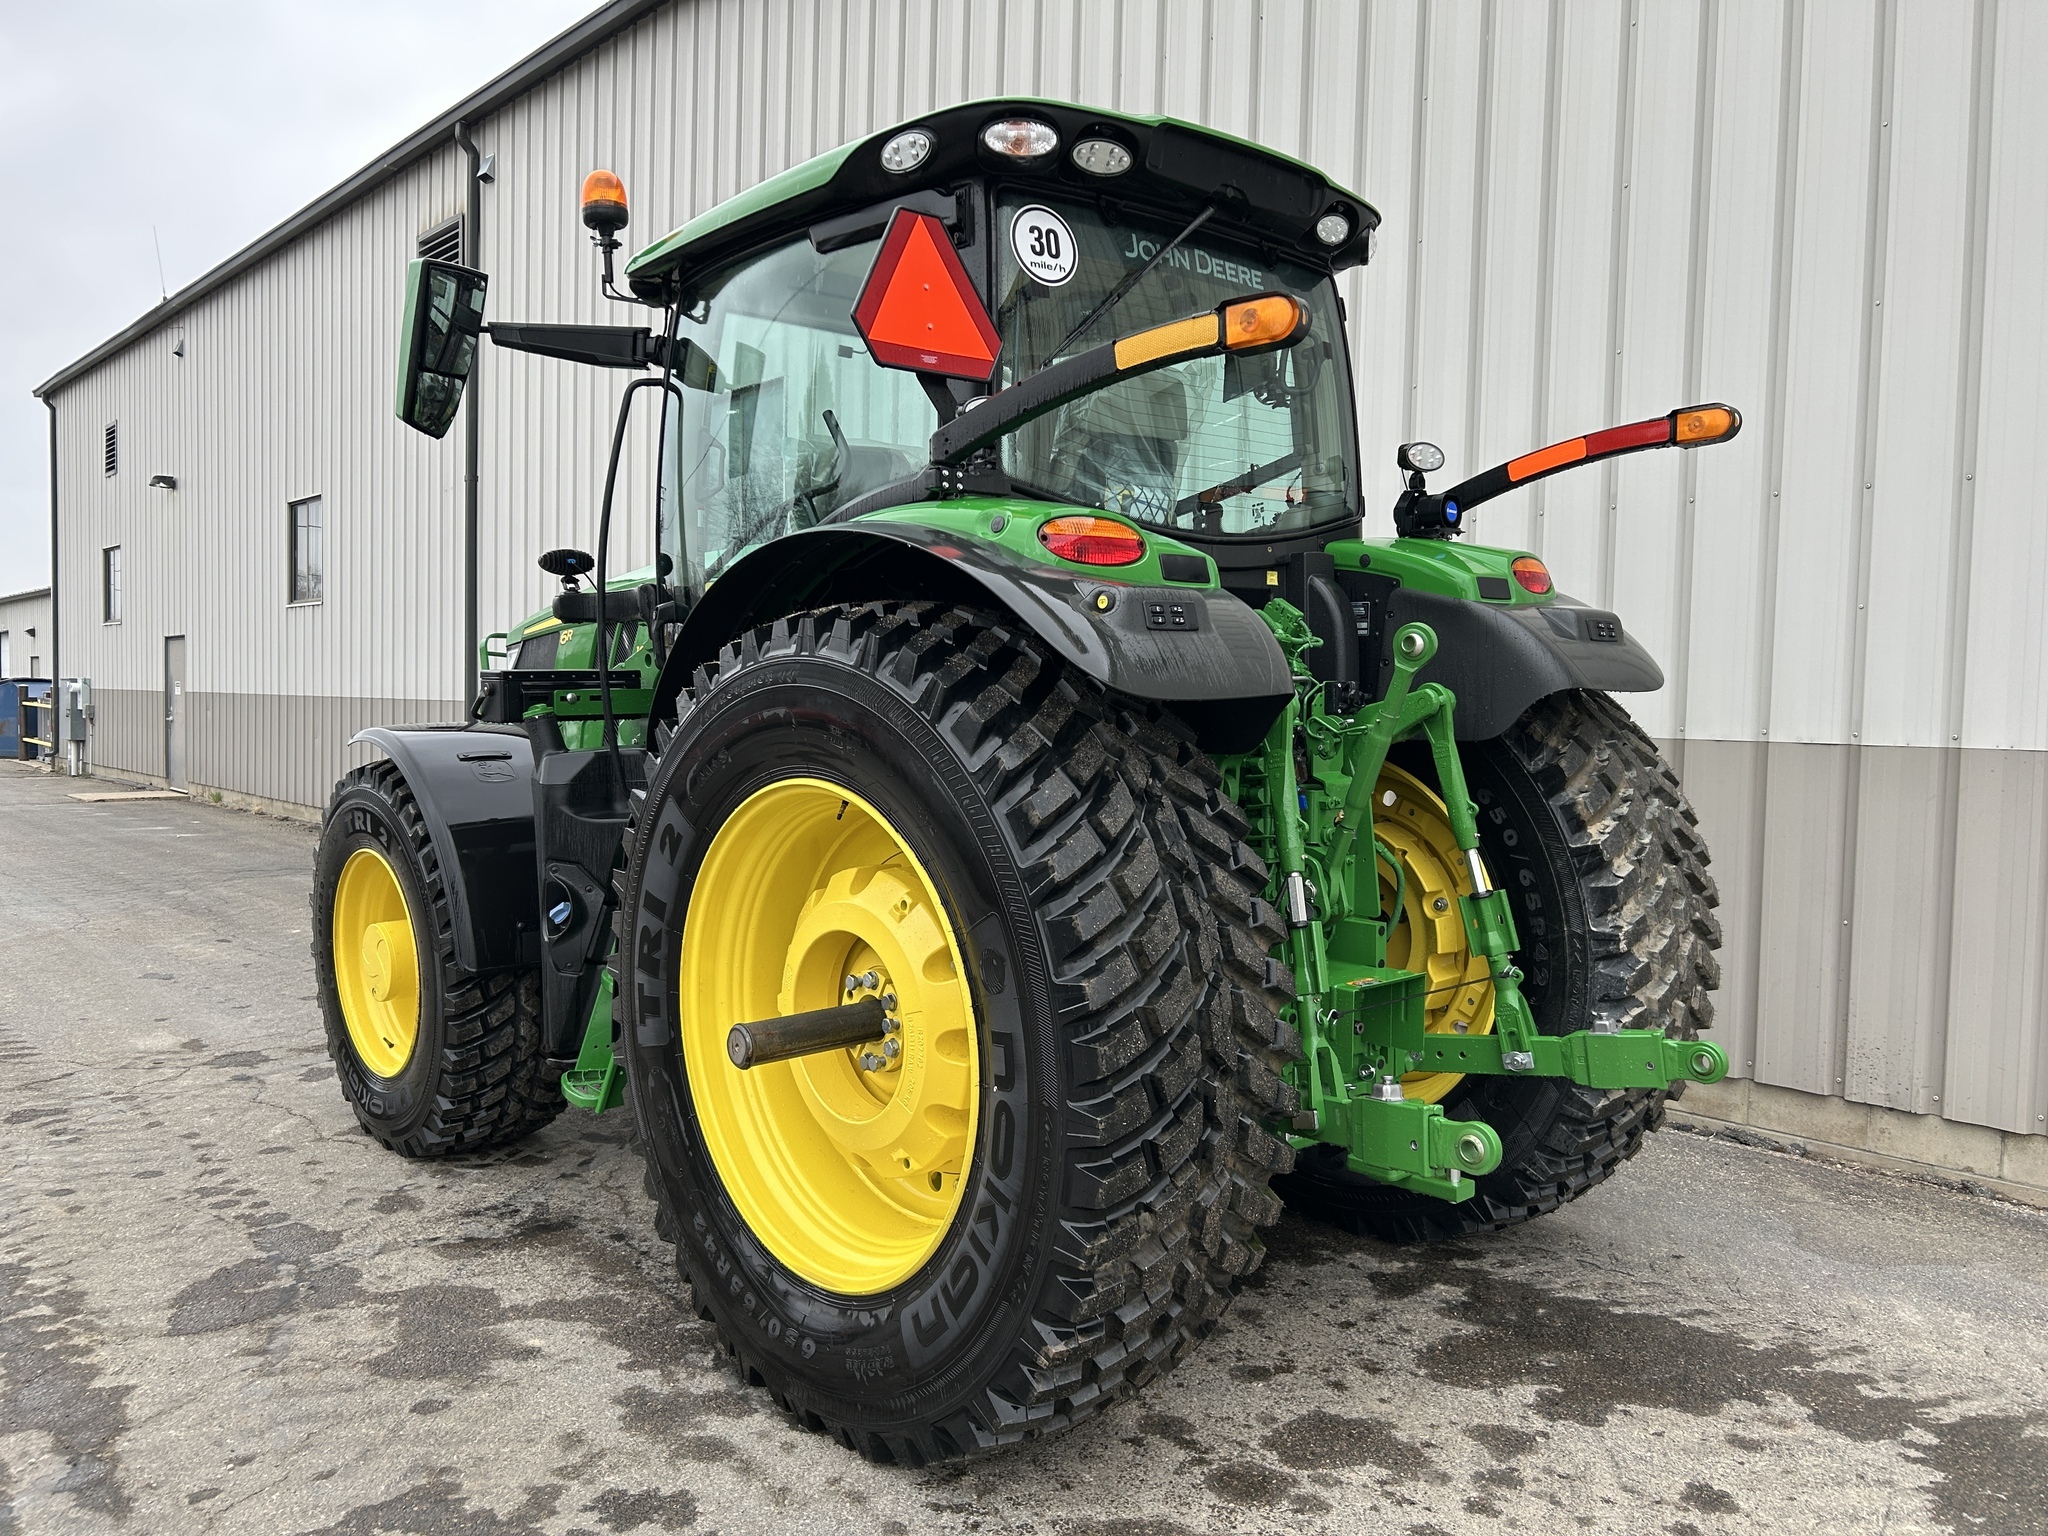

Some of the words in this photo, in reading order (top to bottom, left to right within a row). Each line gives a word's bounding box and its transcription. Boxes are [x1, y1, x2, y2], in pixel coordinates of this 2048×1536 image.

[1028, 225, 1061, 260] 30
[1030, 259, 1067, 274] mile/h
[1195, 249, 1265, 290] DEERE
[559, 629, 574, 646] 6R
[344, 810, 372, 834] TRI
[379, 826, 388, 848] 2
[1477, 788, 1550, 986] 650/65R42
[637, 889, 668, 1027] TRI
[659, 822, 684, 867] 2
[693, 1211, 817, 1360] 650/65R42
